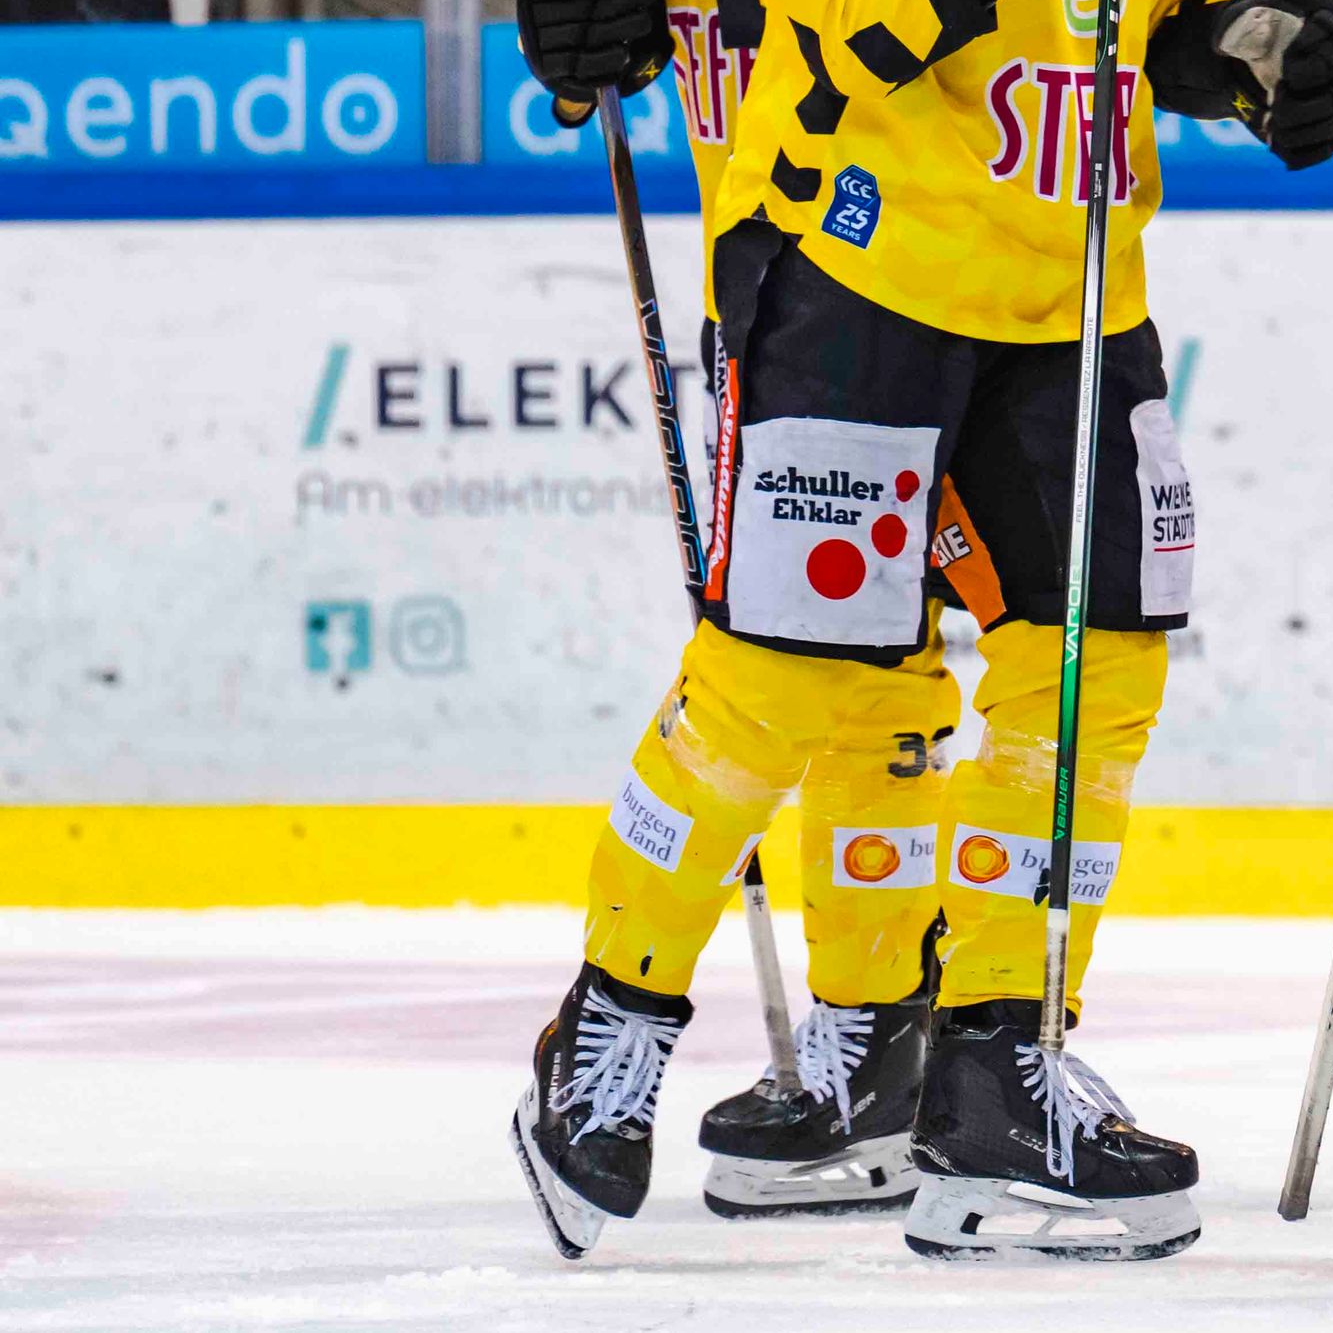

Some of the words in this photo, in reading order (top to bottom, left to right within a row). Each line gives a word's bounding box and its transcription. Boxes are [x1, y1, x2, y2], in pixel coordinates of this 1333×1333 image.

[839, 174, 874, 201] ICE
[830, 222, 862, 242] YEARS
[835, 202, 872, 231] 25
[753, 466, 885, 503] Schuller
[622, 781, 677, 843] burgen
[626, 820, 672, 863] land
